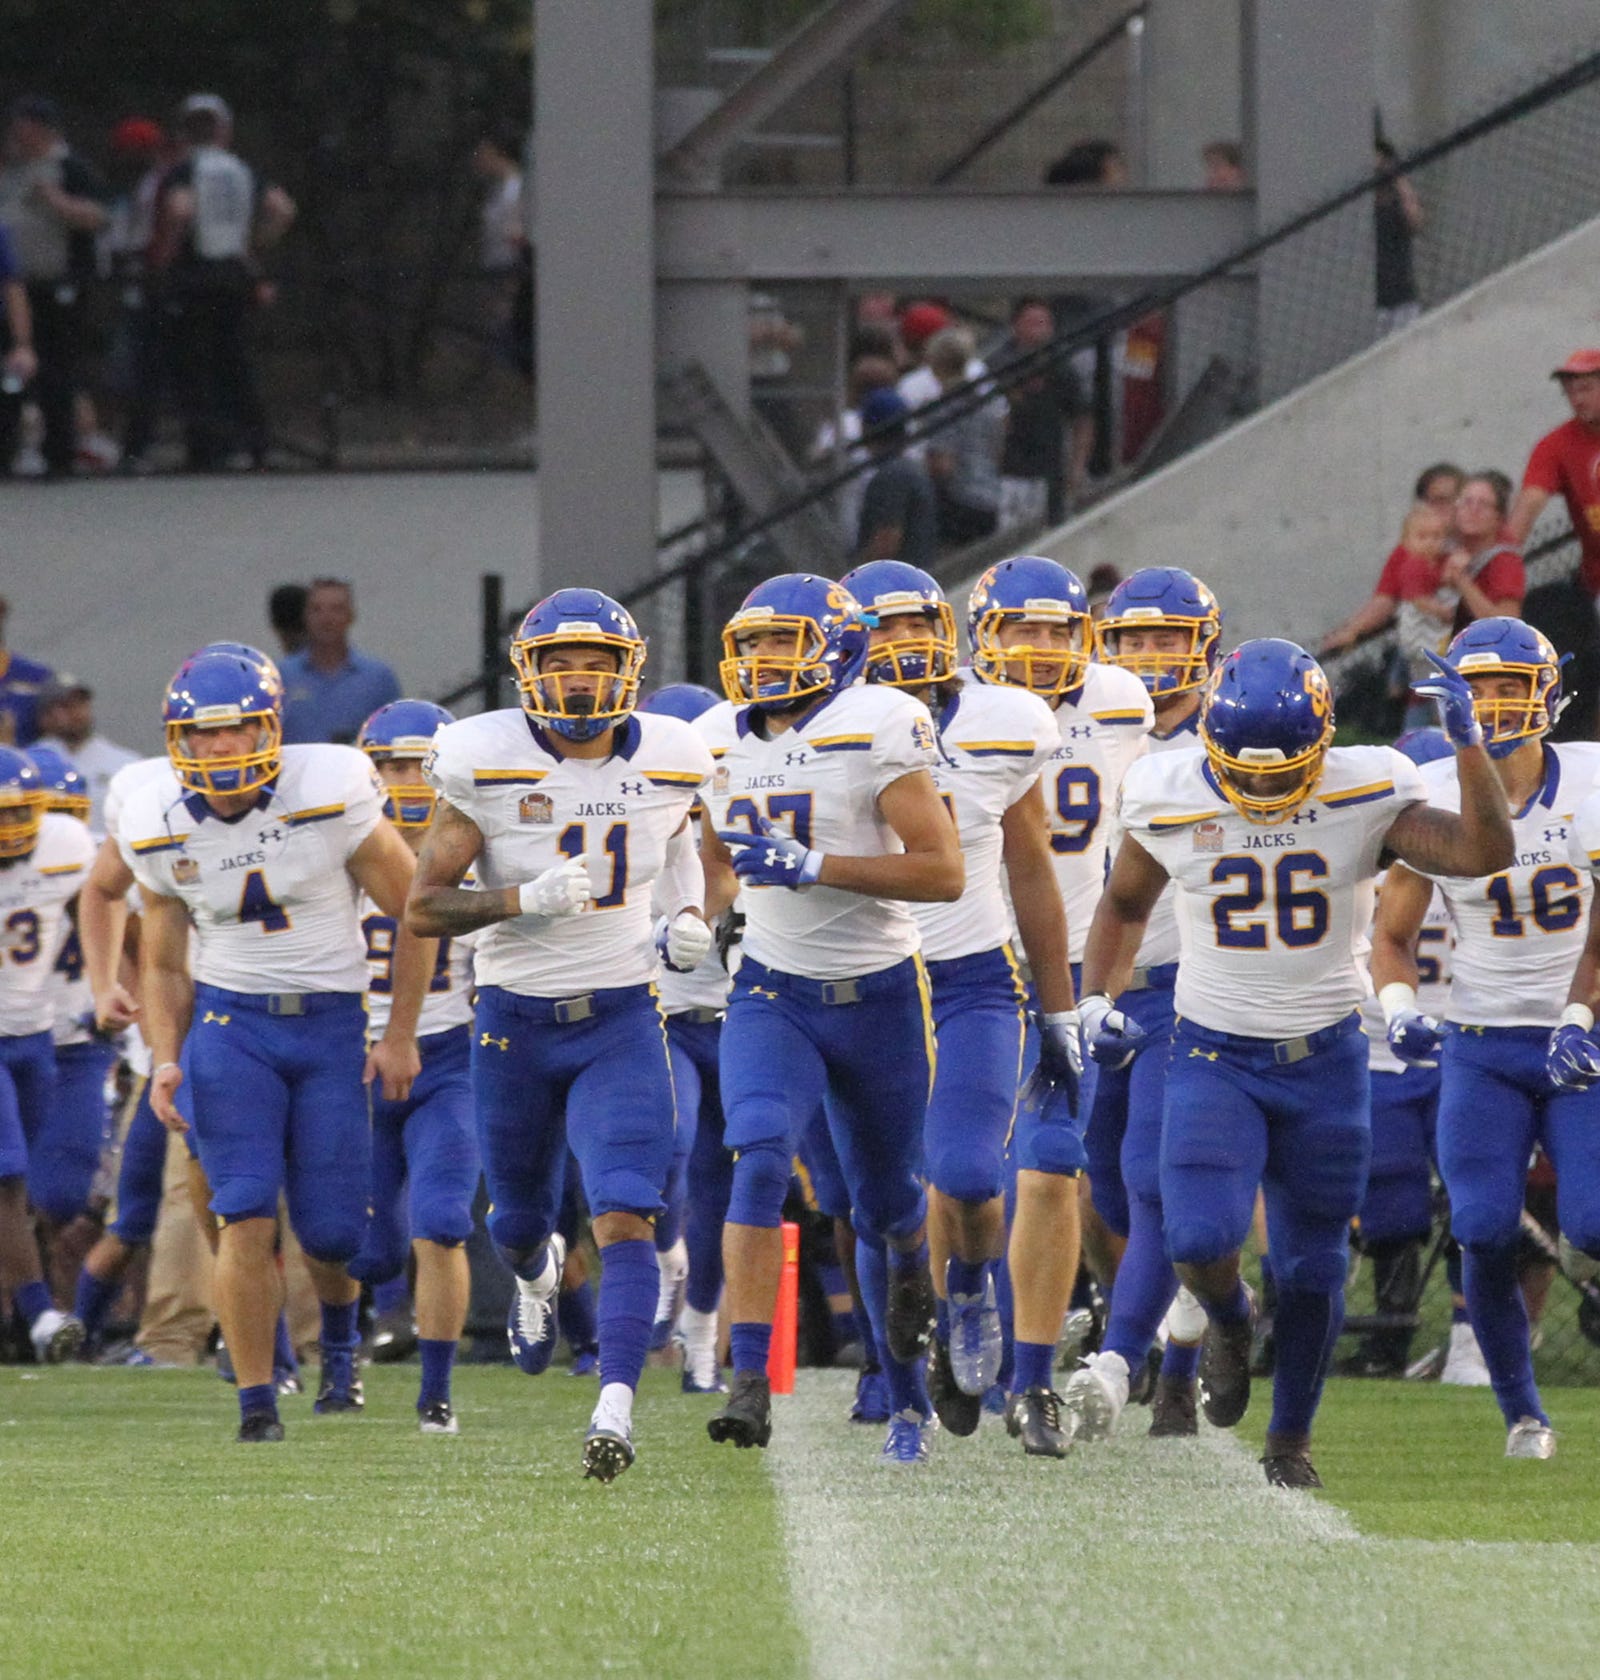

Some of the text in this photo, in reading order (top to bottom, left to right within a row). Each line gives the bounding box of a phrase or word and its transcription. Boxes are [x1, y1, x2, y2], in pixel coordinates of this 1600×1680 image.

[745, 774, 785, 790] JACKS
[575, 802, 627, 816] JACKS
[1242, 832, 1297, 849] JACKS
[219, 851, 266, 871] JACKS
[1512, 850, 1552, 868] ACKS
[238, 867, 293, 935] 4
[1210, 849, 1331, 951] 26
[1486, 863, 1583, 939] 16
